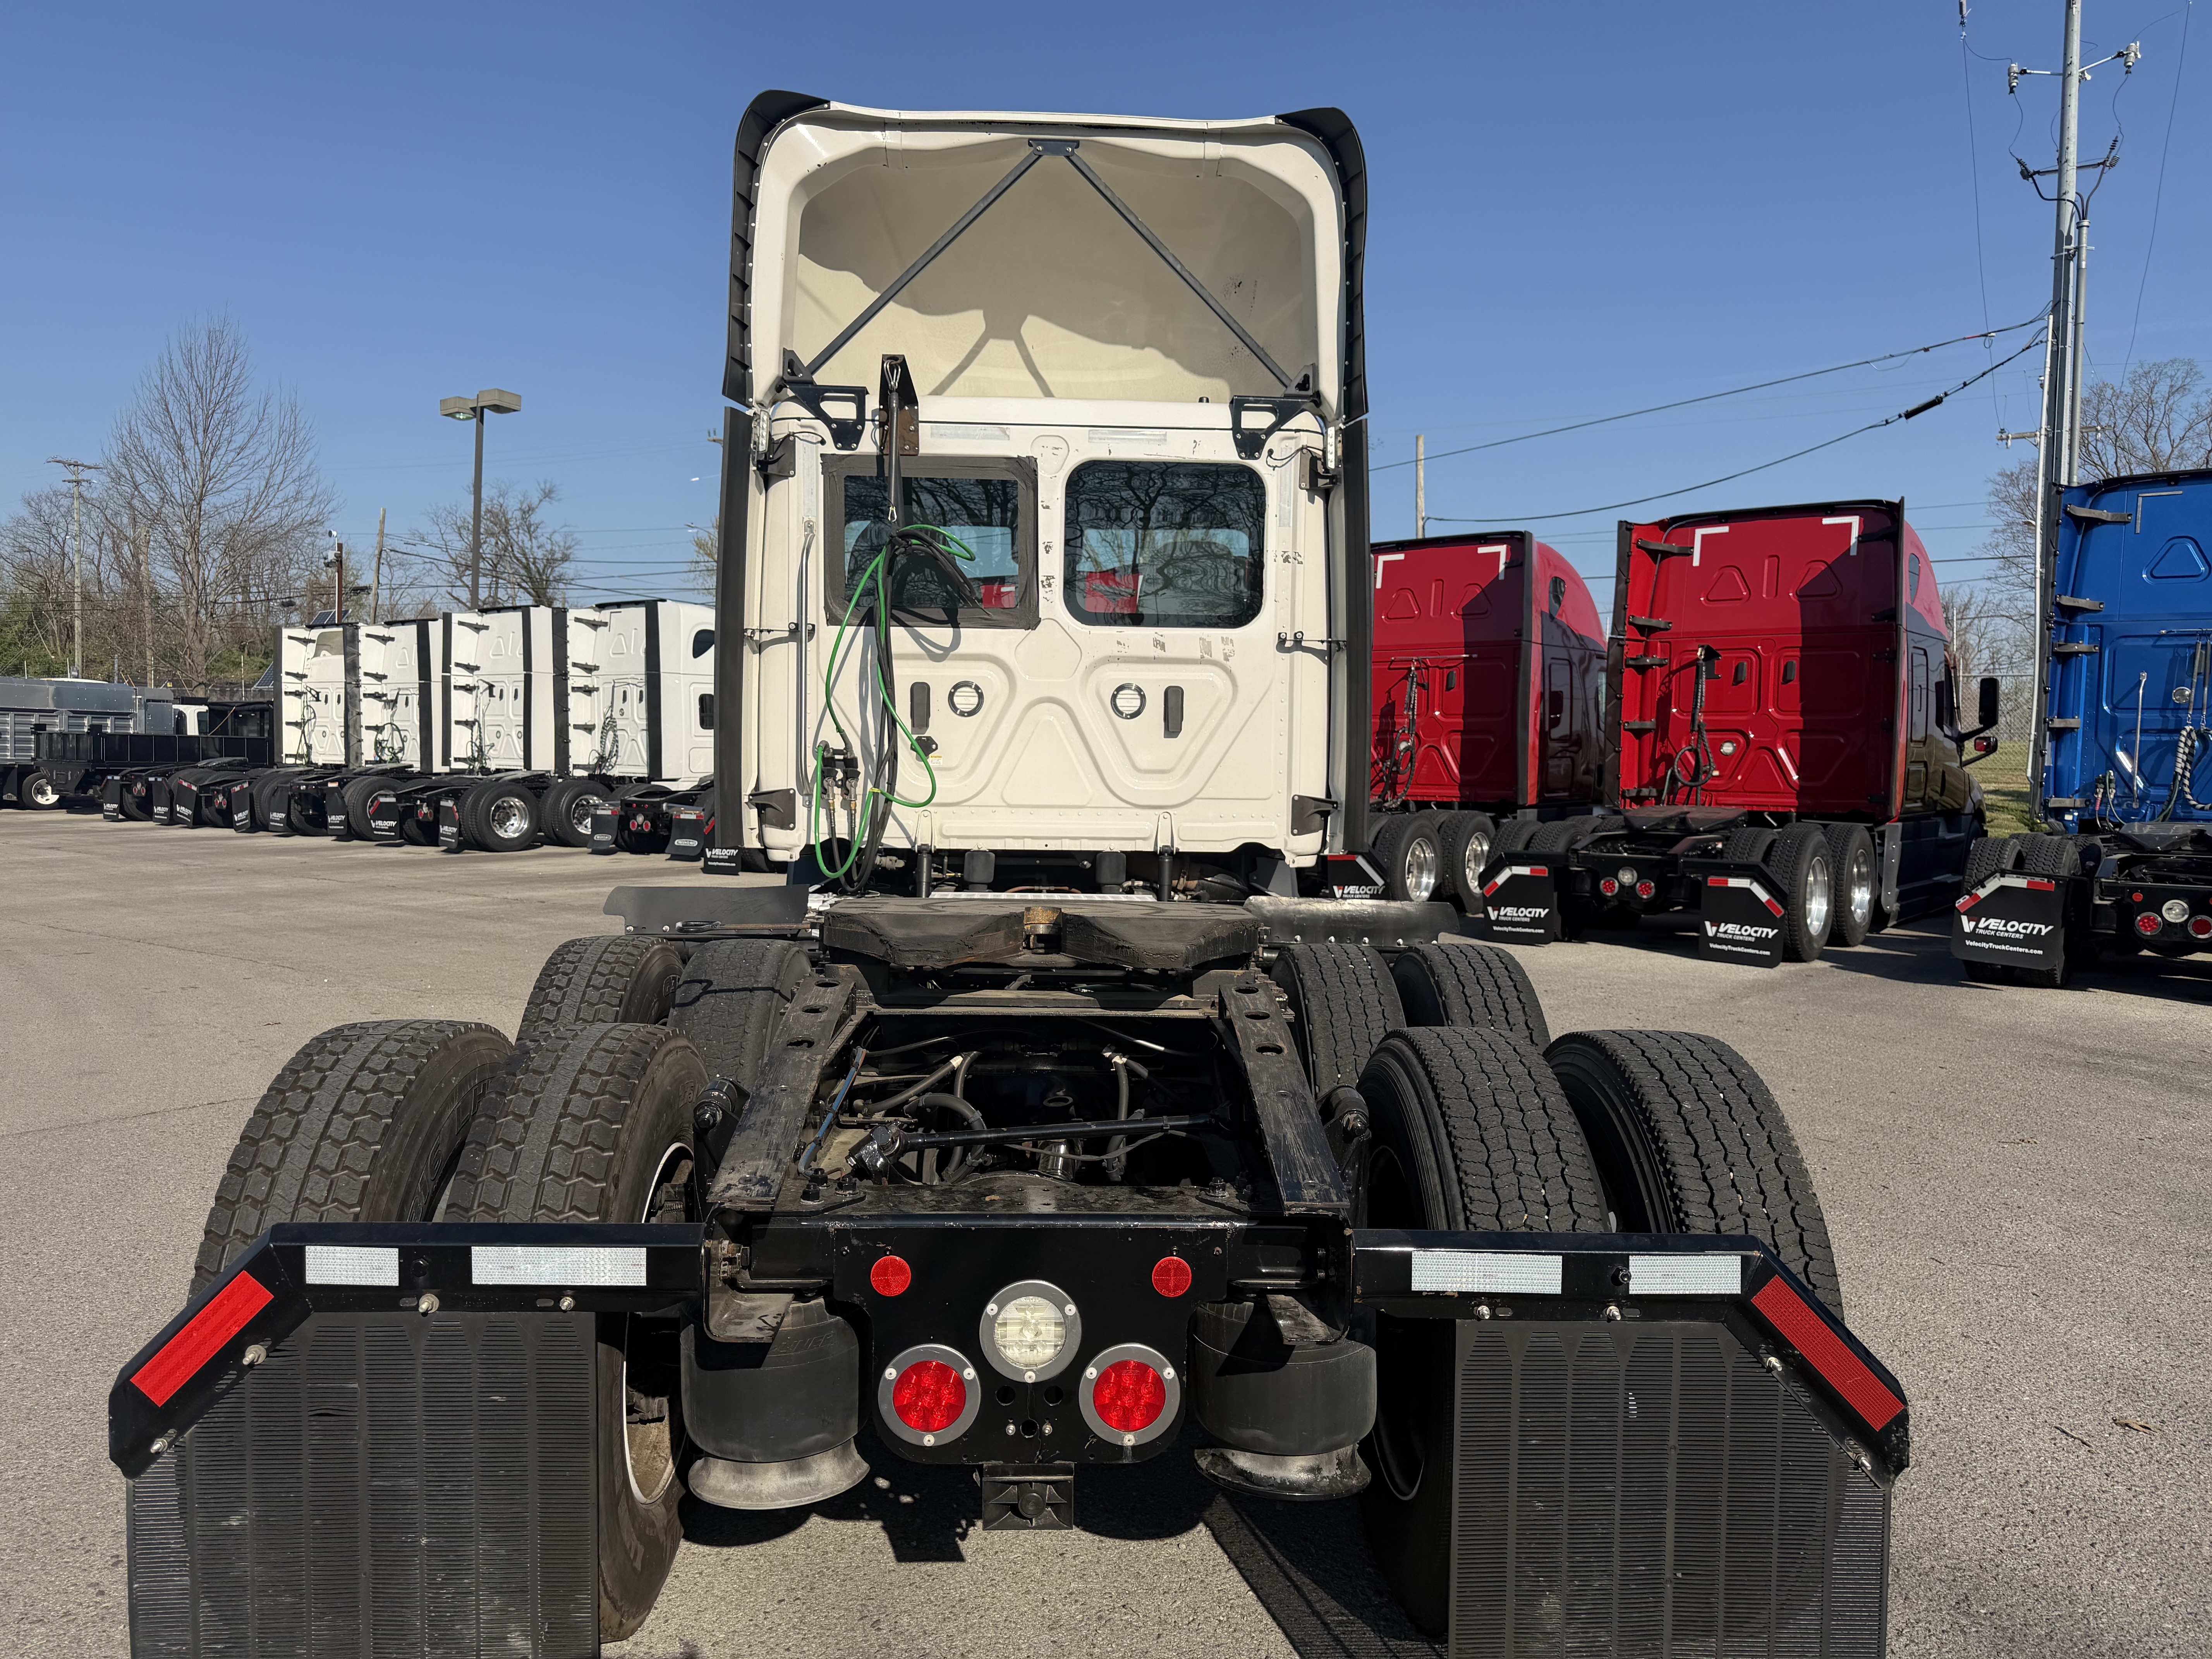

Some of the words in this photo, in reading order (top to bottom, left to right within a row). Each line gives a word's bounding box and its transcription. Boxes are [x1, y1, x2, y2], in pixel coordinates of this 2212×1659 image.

[1343, 885, 1385, 894] VELOCITY
[1499, 907, 1549, 918] VELOCITY
[1719, 923, 1779, 939] VELOCITY
[1978, 917, 2054, 936] VELOCITY
[1996, 931, 2024, 939] CENTERS
[1965, 940, 2043, 955] VelocityTruckCenters.com
